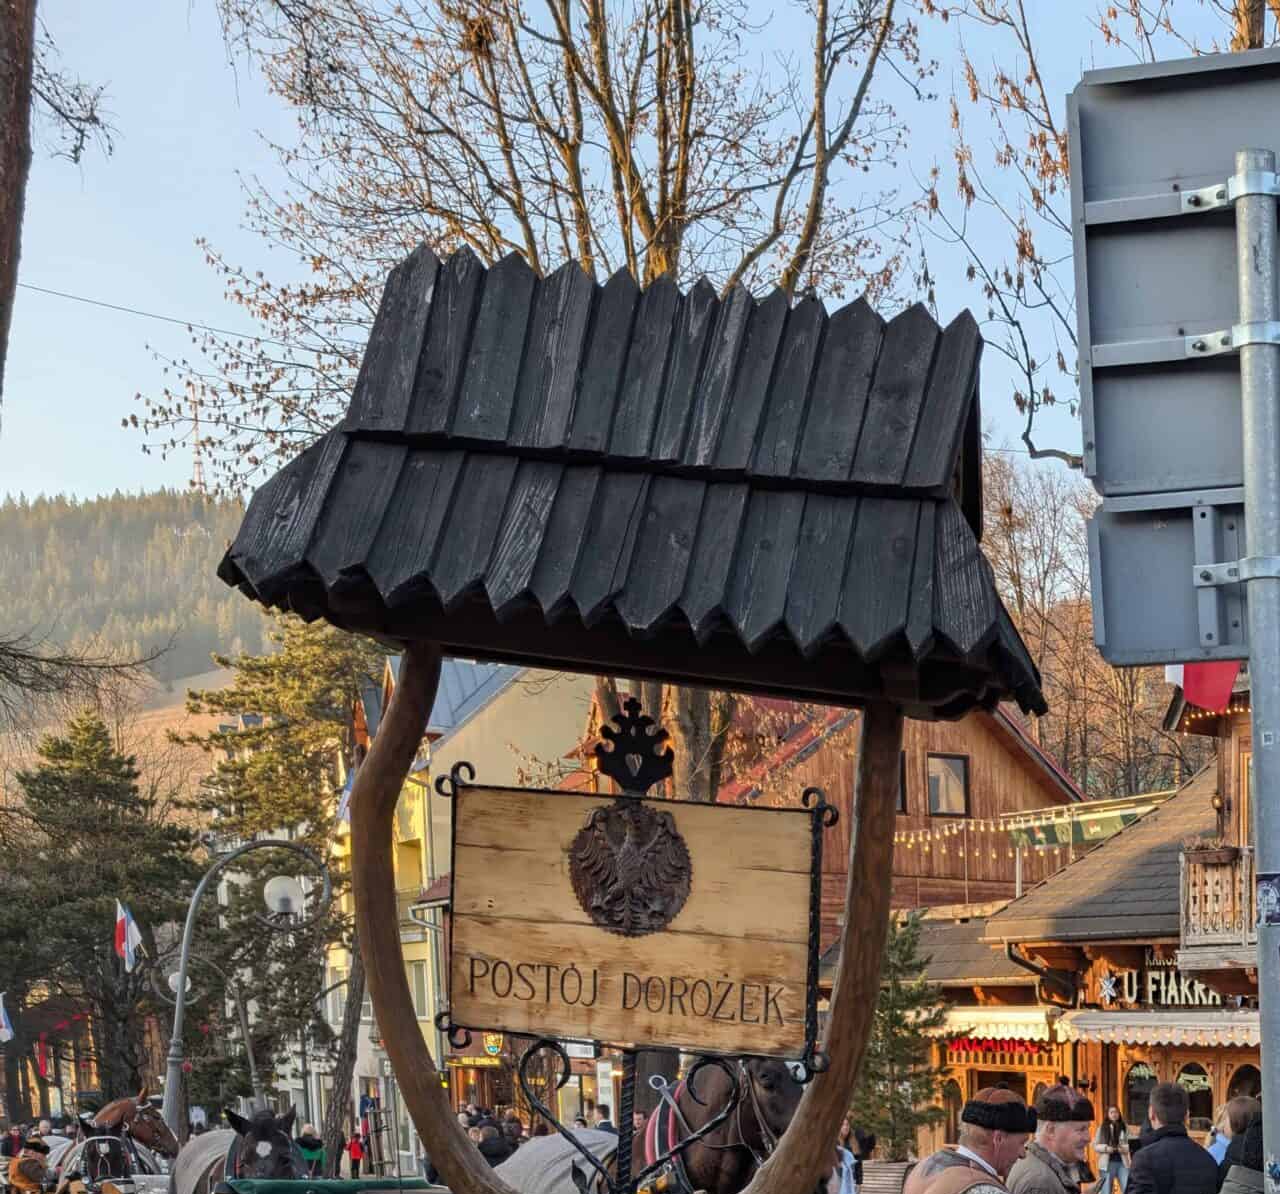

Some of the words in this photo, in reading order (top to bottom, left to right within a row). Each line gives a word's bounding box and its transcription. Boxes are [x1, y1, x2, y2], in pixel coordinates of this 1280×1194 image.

[469, 957, 598, 1008] POSTÓJ
[622, 971, 785, 1026] DOROŻEK
[1124, 969, 1138, 1004] U
